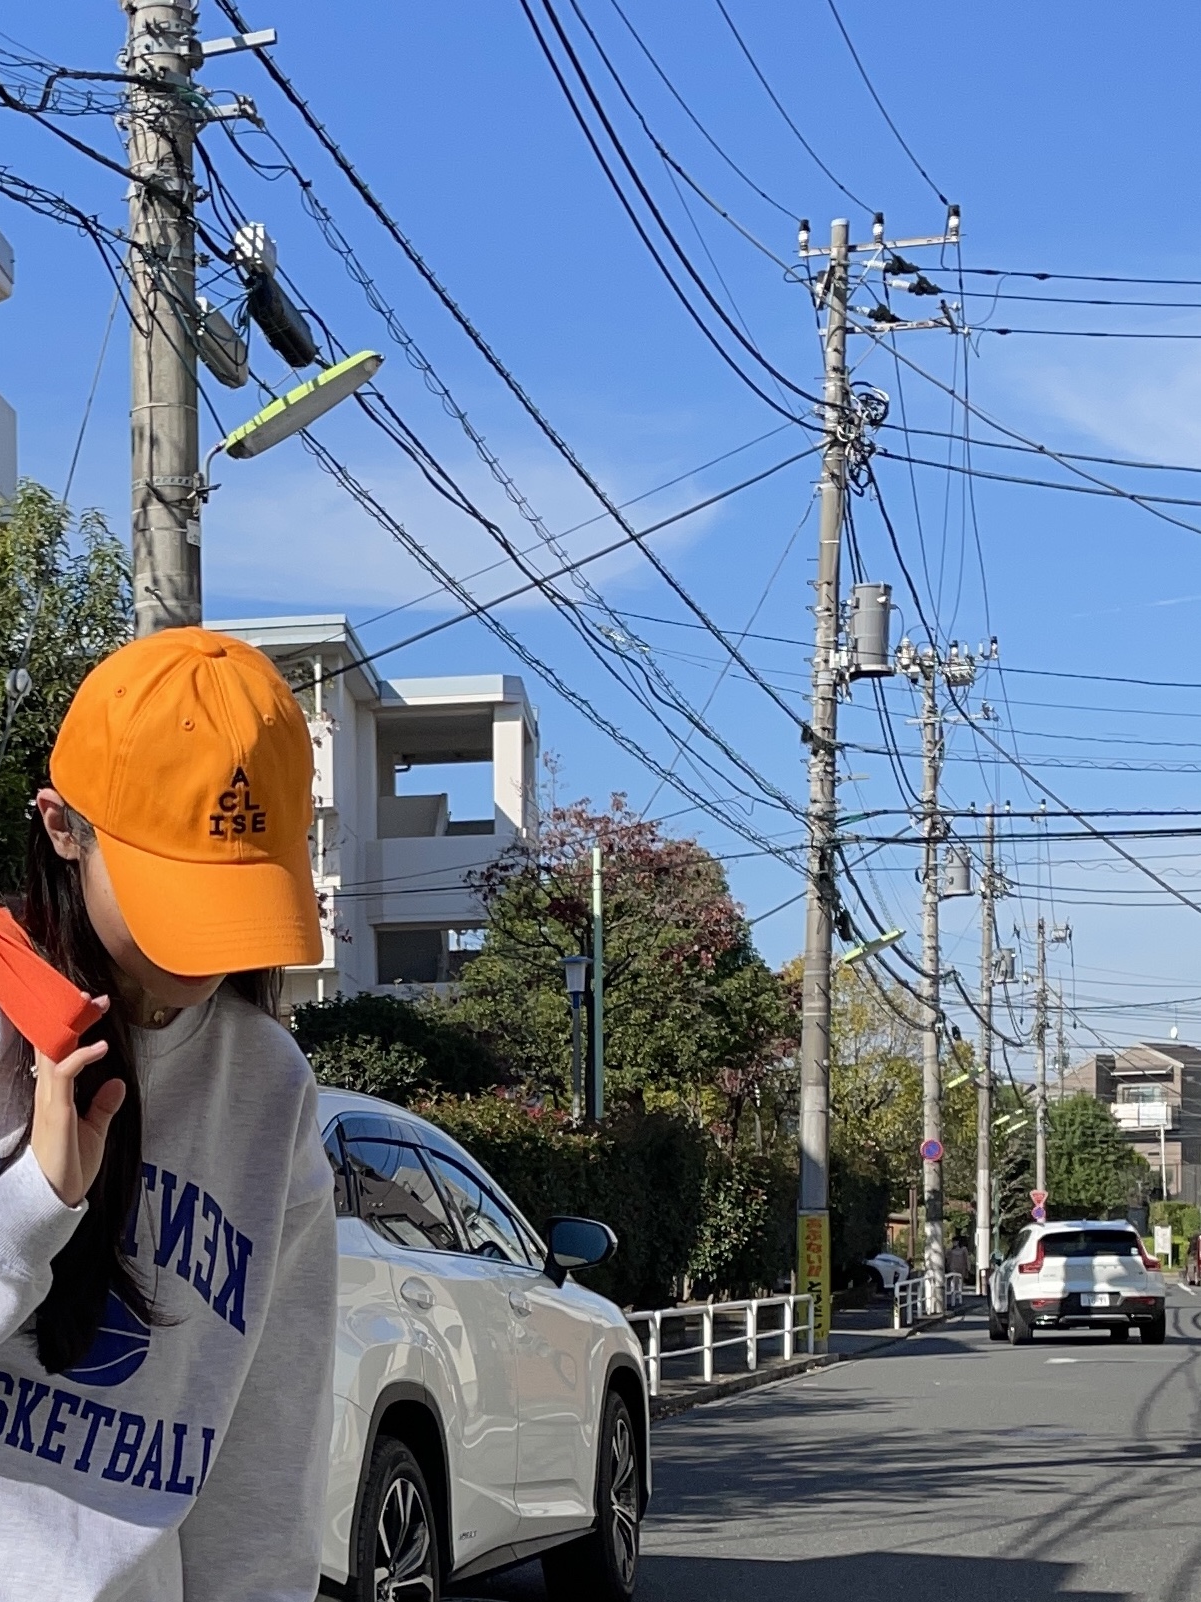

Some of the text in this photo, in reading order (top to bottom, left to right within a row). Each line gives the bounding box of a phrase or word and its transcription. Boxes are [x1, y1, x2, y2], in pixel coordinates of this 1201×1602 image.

[231, 766, 249, 787] A
[219, 791, 260, 812] CL
[209, 812, 266, 836] ISE
